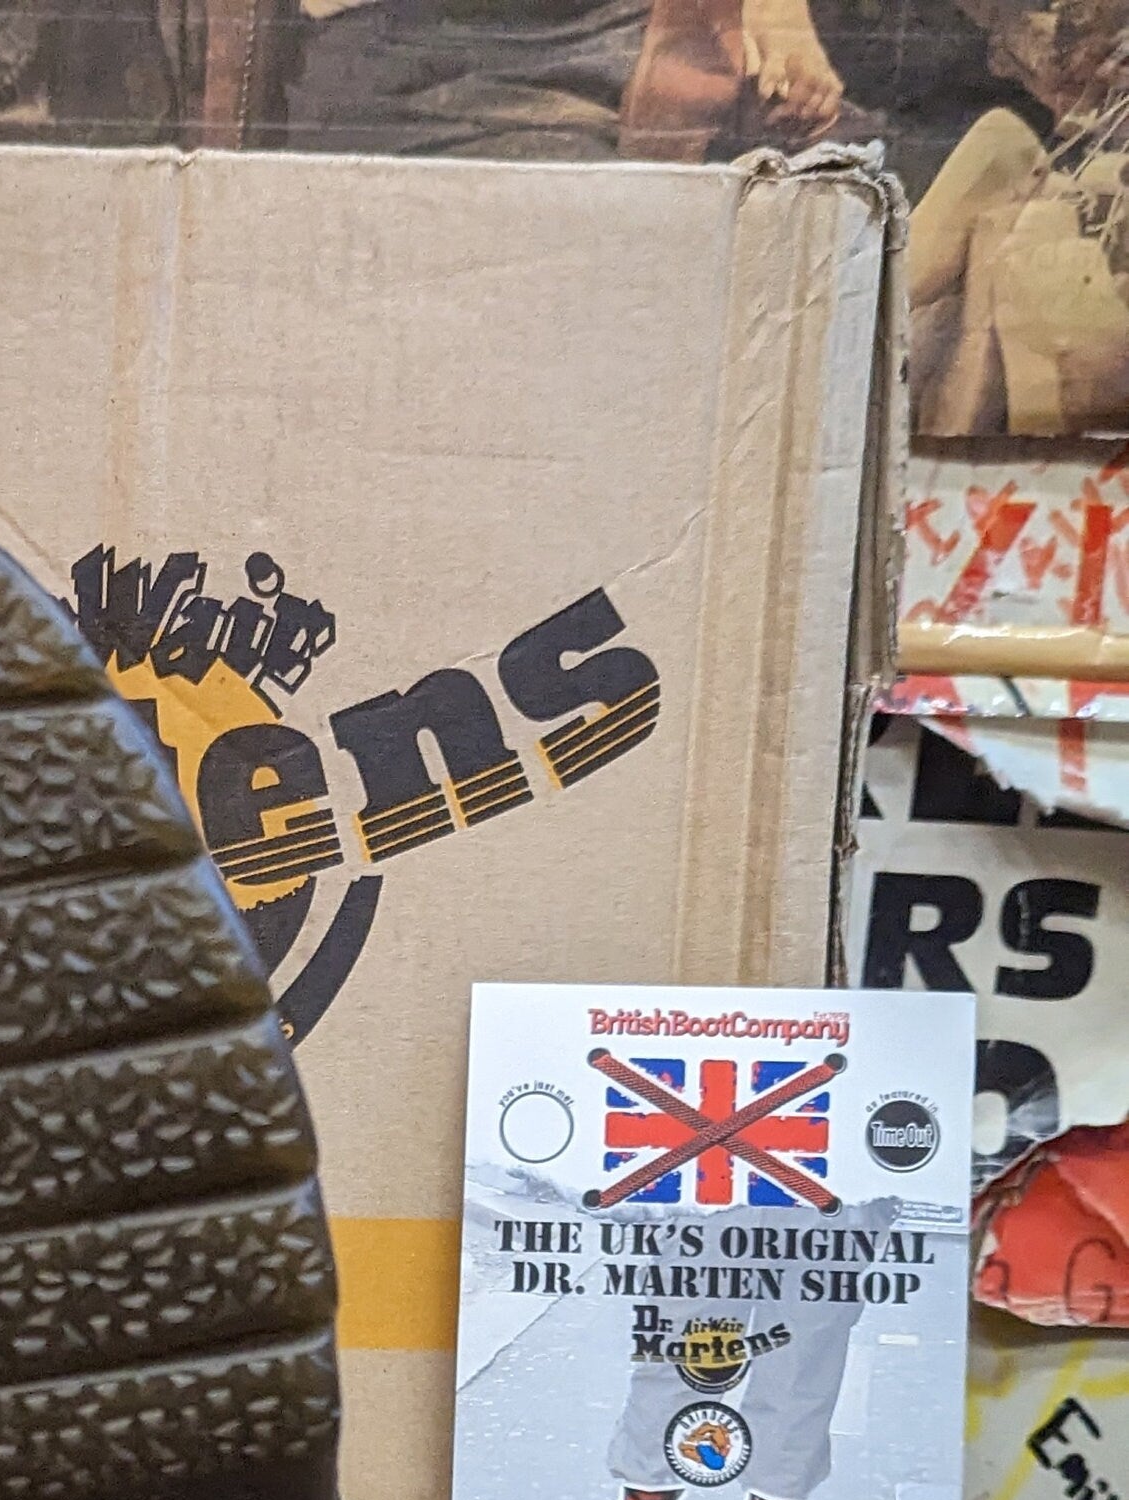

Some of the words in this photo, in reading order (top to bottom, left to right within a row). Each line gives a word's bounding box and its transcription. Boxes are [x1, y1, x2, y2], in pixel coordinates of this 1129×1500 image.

[588, 1008, 850, 1048] BritishBootCompany
[498, 1083, 530, 1107] you've
[533, 1079, 555, 1092] just
[556, 1089, 575, 1106] met
[879, 1090, 929, 1102] featured
[494, 1219, 583, 1254] THE
[599, 1223, 705, 1258] UK'S
[719, 1226, 936, 1265] ORIGINAL
[512, 1261, 586, 1296] DR.
[604, 1264, 783, 1301] MARTEN
[800, 1269, 922, 1305] SHOP
[632, 1304, 674, 1333] Dr.
[630, 1322, 792, 1364] Martens
